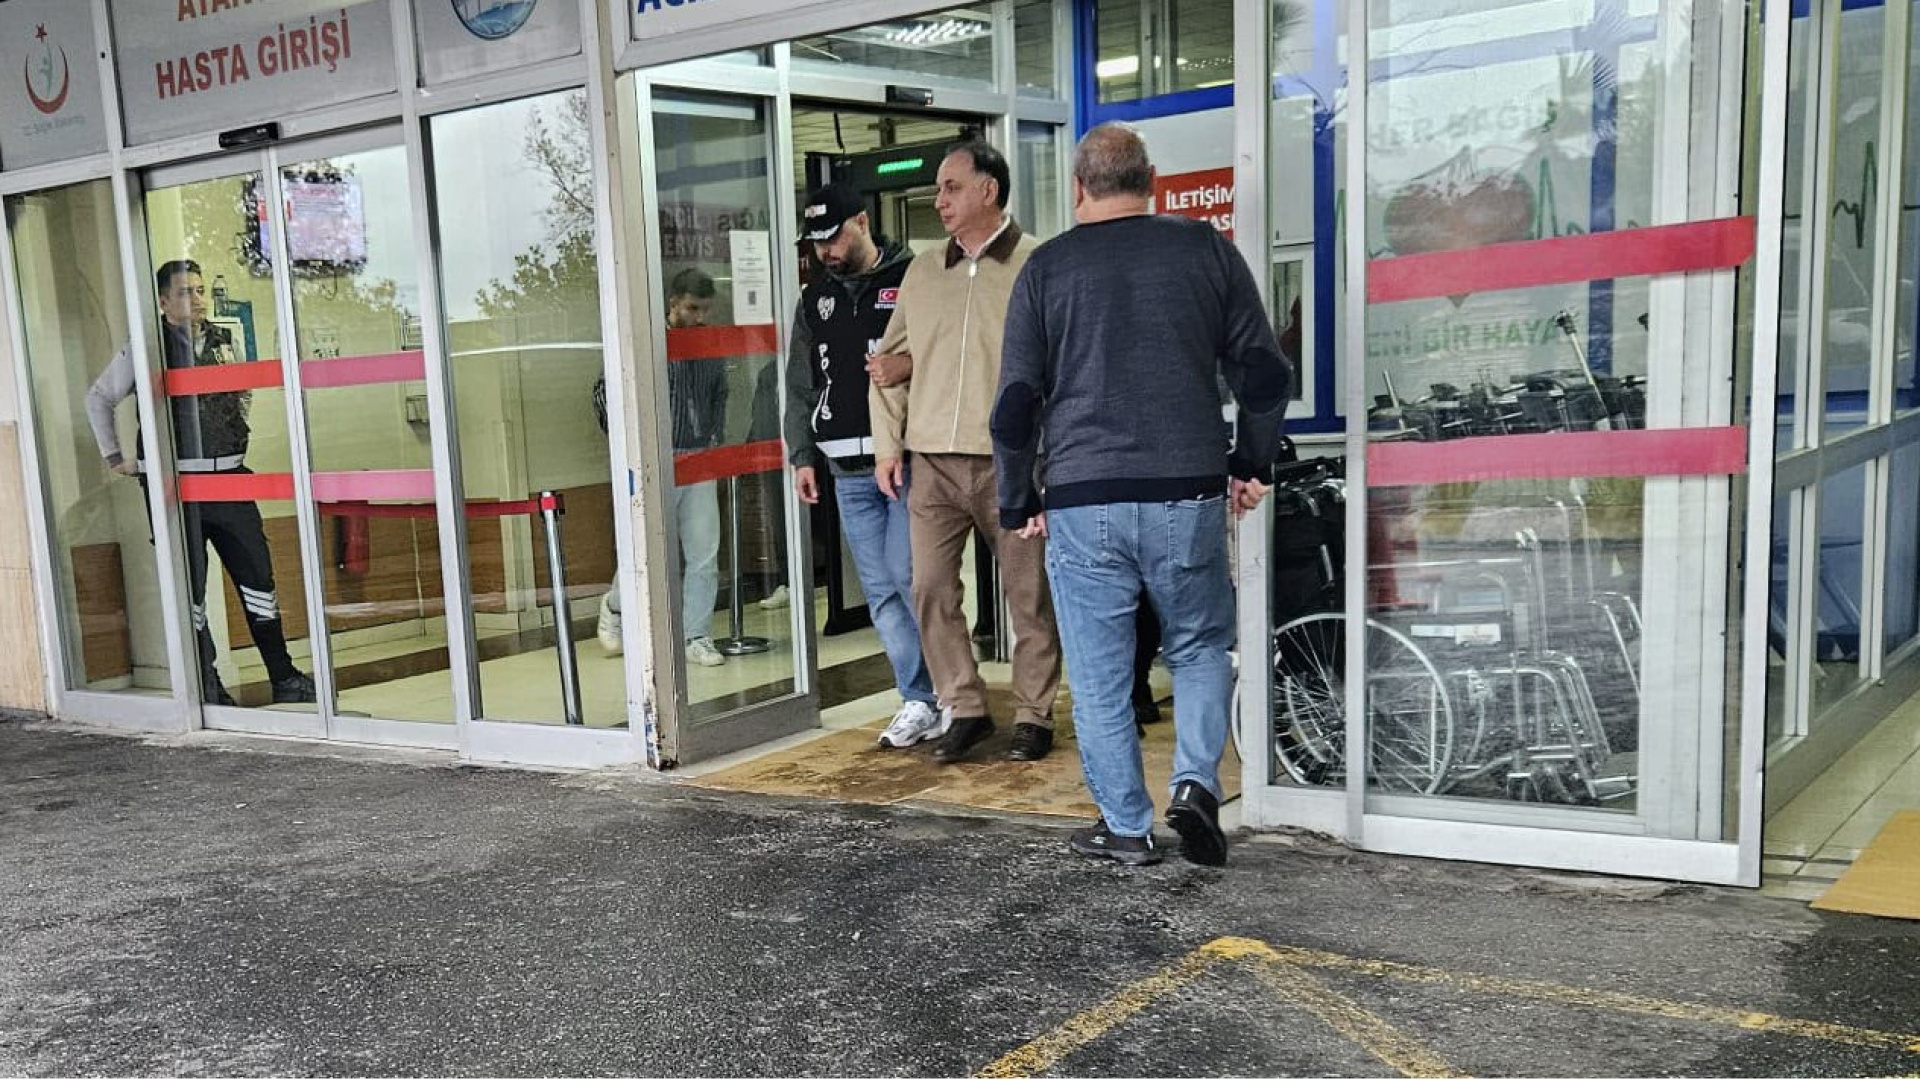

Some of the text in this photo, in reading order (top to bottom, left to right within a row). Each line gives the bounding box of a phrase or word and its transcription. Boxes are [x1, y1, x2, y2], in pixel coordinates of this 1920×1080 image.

[156, 8, 351, 99] HASTA GİRİŞİ
[1166, 184, 1235, 211] İLETİŞİM
[1484, 315, 1560, 345] HAYA
